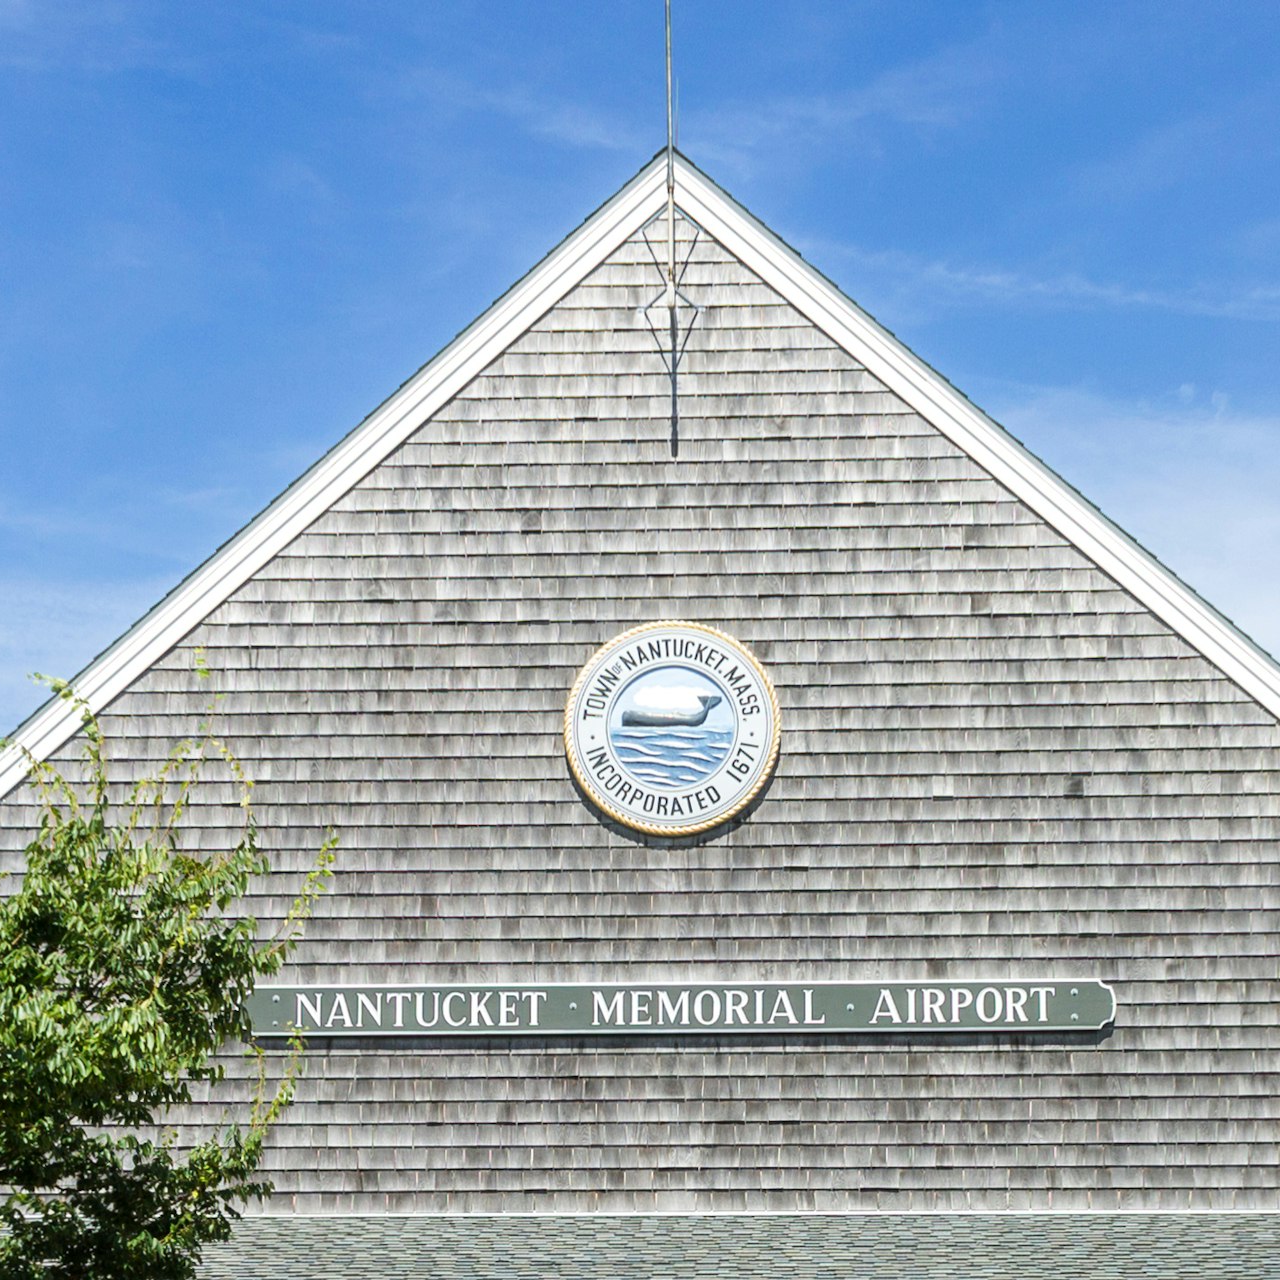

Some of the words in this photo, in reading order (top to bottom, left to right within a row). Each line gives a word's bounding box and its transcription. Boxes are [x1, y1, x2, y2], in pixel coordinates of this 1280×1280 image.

[583, 668, 620, 720] TOWN
[586, 746, 721, 816] INCORPORATED
[726, 742, 759, 783] 1671
[294, 991, 547, 1028] NANTUCKET
[591, 989, 826, 1026] MEMORIAL
[868, 987, 1056, 1024] AIRPORT
